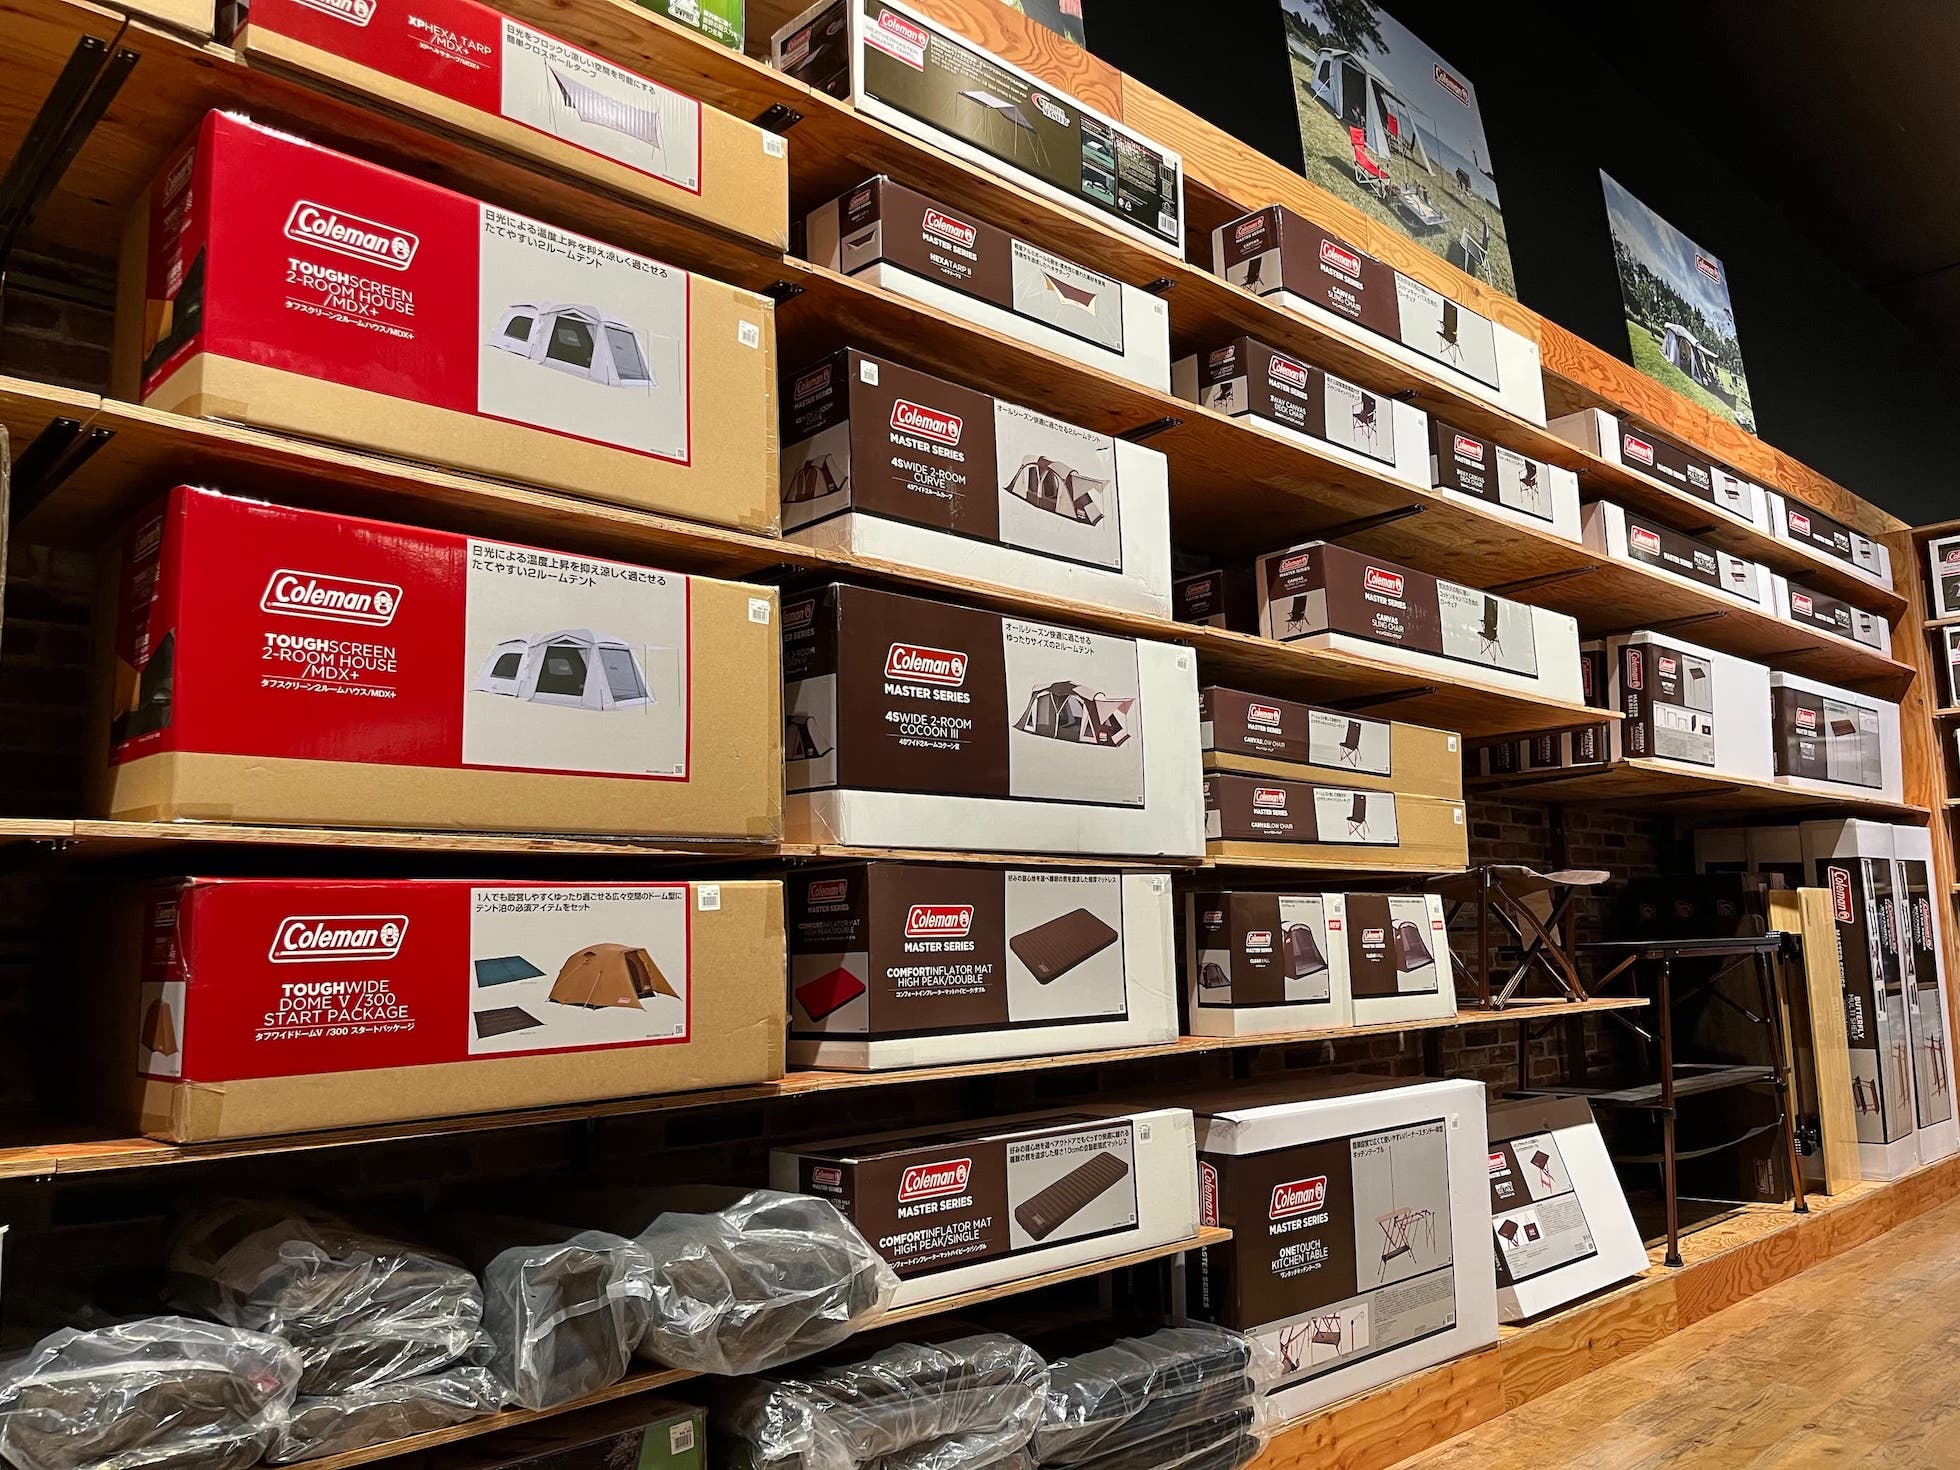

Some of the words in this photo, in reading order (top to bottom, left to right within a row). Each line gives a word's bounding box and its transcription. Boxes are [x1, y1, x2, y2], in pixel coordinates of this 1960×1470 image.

[408, 14, 457, 42] XPHEXA
[462, 37, 493, 56] TARP
[882, 13, 919, 41] Coleman
[430, 34, 471, 56] /MDX+
[298, 208, 390, 254] Coleman
[927, 212, 964, 238] Coleman
[485, 209, 668, 279] 日光による温度上昇を抑え涼しく過ごせる
[485, 222, 602, 268] たてやすい2ルームテント
[922, 232, 952, 251] MASTER
[953, 244, 978, 262] SERIES
[1323, 244, 1353, 268] Coleman
[288, 257, 413, 303] TOUGHSCREEN
[1320, 263, 1344, 282] MASTER
[286, 270, 355, 300] 2-ROOM
[360, 291, 415, 316] HOUSE
[323, 294, 379, 316] /MDX+
[1272, 359, 1299, 380] Coleman
[897, 404, 947, 434] Coleman
[890, 433, 931, 453] MASTER
[932, 444, 965, 462] SERIES
[891, 457, 929, 475] 4SWIDE
[930, 467, 966, 485] 2-ROOM
[914, 472, 946, 489] CURVE
[472, 559, 597, 587] たてやすい2ルームテント
[473, 545, 666, 586] 日光による温度上昇を抑え涼しく過ごせる
[1367, 570, 1396, 590] Coleman
[275, 576, 372, 611] Coleman
[1365, 592, 1387, 605] MASTER
[1388, 599, 1407, 610] SERIES
[1376, 613, 1399, 625] CANVAS
[264, 632, 395, 659] TOUGHSCREEN
[1005, 623, 1092, 645] オールシーズン快適に過ごせる
[1006, 634, 1095, 655] ゆったりサイズの2ルームテント
[262, 647, 335, 666] 2-ROOM
[340, 655, 397, 672] HOUSE
[892, 648, 950, 675] Coleman
[1631, 652, 1640, 682] Coleman
[301, 663, 359, 681] /MDX+
[884, 683, 931, 699] MASTER
[932, 689, 971, 703] SERIES
[885, 711, 928, 725] 4SWIDE
[930, 716, 972, 730] 2-ROOM
[1251, 706, 1273, 720] Coleman
[900, 724, 947, 737] COCOON
[1256, 790, 1279, 802] Coleman
[1834, 872, 1848, 911] Coleman
[476, 903, 590, 912] テント泊の必須アイテムをセット
[911, 909, 959, 928] Coleman
[283, 923, 379, 950] Coleman
[904, 942, 943, 952] MASTER
[943, 941, 975, 951] SERIES
[887, 965, 973, 978] COMFORTINFLATOR
[974, 964, 992, 974] MAT
[898, 977, 919, 987] HIGH
[921, 974, 983, 986] PEAK/DOUBLE
[282, 980, 390, 996] TOUGHWIDE
[280, 996, 332, 1011] DOME
[339, 995, 350, 1007] V
[355, 993, 396, 1009] /300
[264, 1010, 323, 1026] START
[328, 1005, 409, 1022] PACKAGE
[1854, 996, 1864, 1039] BUTTERFLY
[326, 1027, 349, 1036] /300
[905, 1169, 955, 1192] Coleman
[1203, 1167, 1215, 1217] Coleman
[898, 1201, 938, 1219] MASTER
[939, 1196, 973, 1211] SERIES
[1274, 1188, 1314, 1210] Coleman
[879, 1220, 971, 1248] COMFORTINFLATOR
[973, 1217, 992, 1231] MAT
[1269, 1219, 1302, 1235] MASTER
[1302, 1213, 1328, 1228] SERIES
[894, 1242, 917, 1256] HIGH
[919, 1229, 980, 1251] PEAK/SINGLE
[1279, 1240, 1320, 1257] ONETOUCH
[1271, 1253, 1304, 1270] KITCHEN
[1305, 1247, 1328, 1261] TABLE
